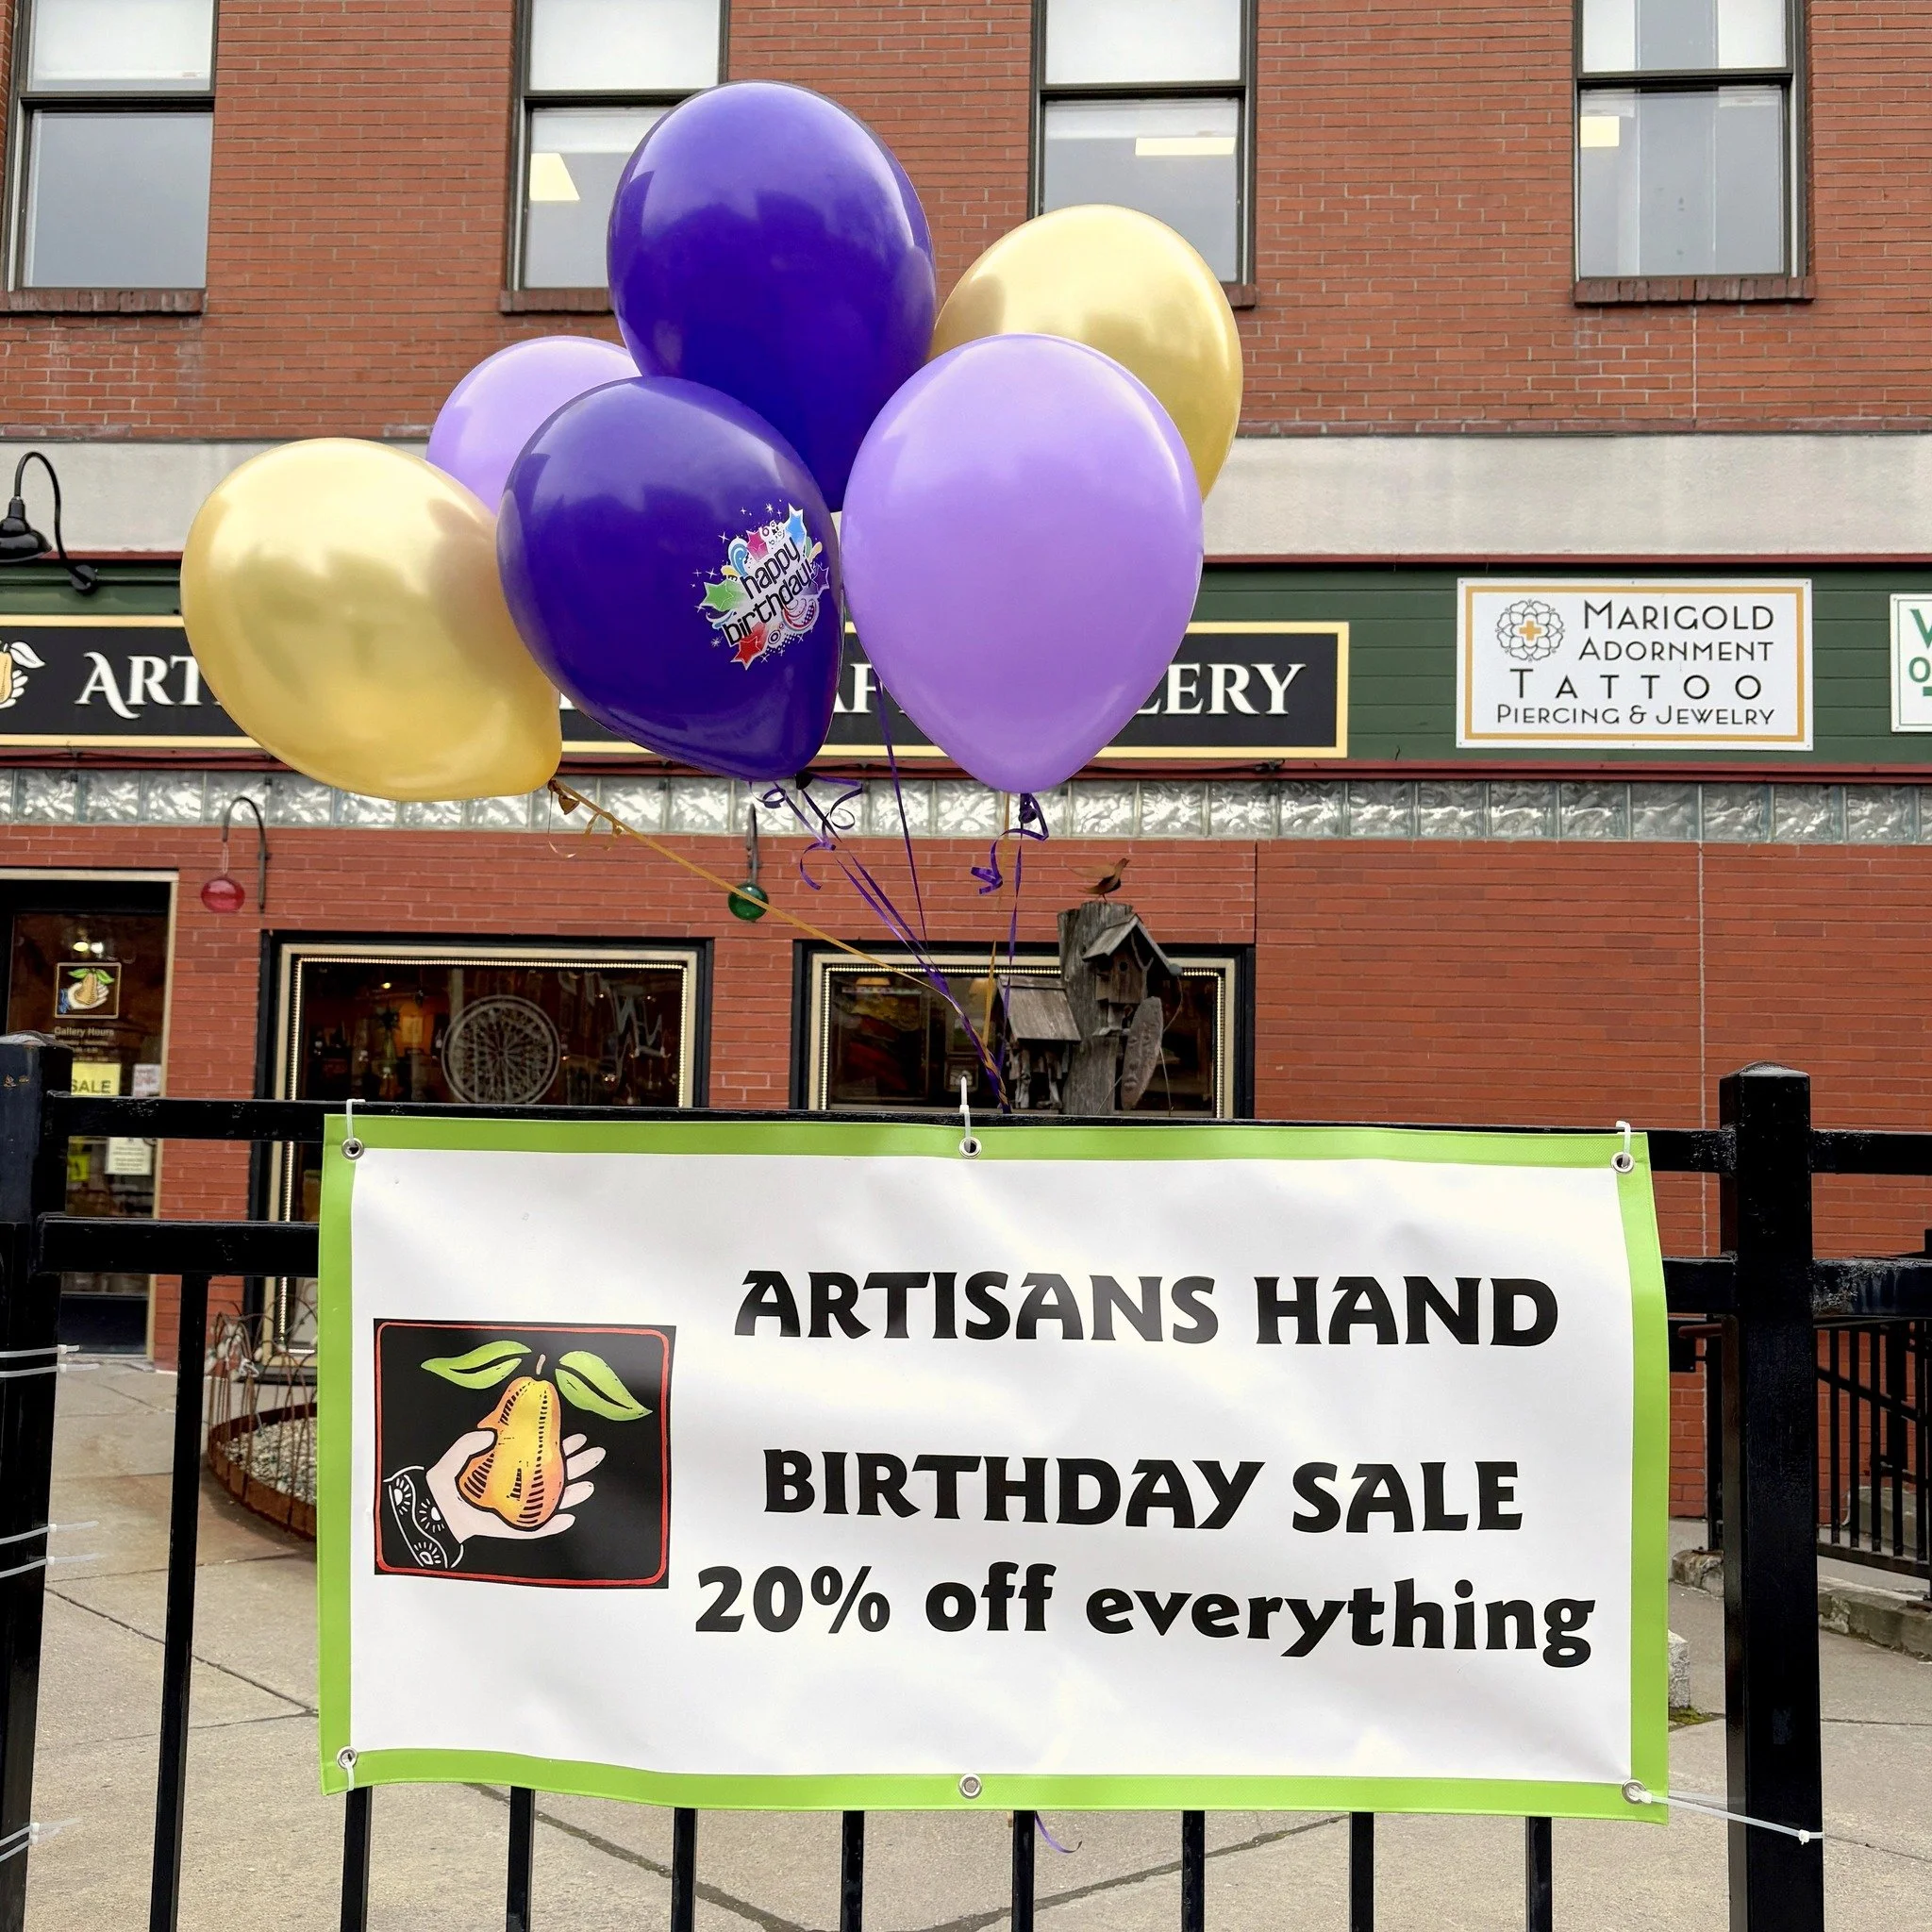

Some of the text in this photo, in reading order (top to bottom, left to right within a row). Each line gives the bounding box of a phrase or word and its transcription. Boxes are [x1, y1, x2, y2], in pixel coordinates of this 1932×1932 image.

[740, 536, 801, 600] happy
[723, 558, 815, 646] birthday!
[1584, 600, 1774, 630] MARIGOLD
[1578, 637, 1774, 661] ADORNMENT
[74, 651, 222, 720] ART
[1497, 704, 1774, 725] PIERCING & JEWELRY
[1509, 668, 1761, 700] TATTOO
[72, 1079, 111, 1094] SALE
[734, 1270, 1558, 1347] ARTISANS HAND
[763, 1448, 1523, 1534] BIRTHDAY SALE
[695, 1561, 1596, 1669] 20% off everything
